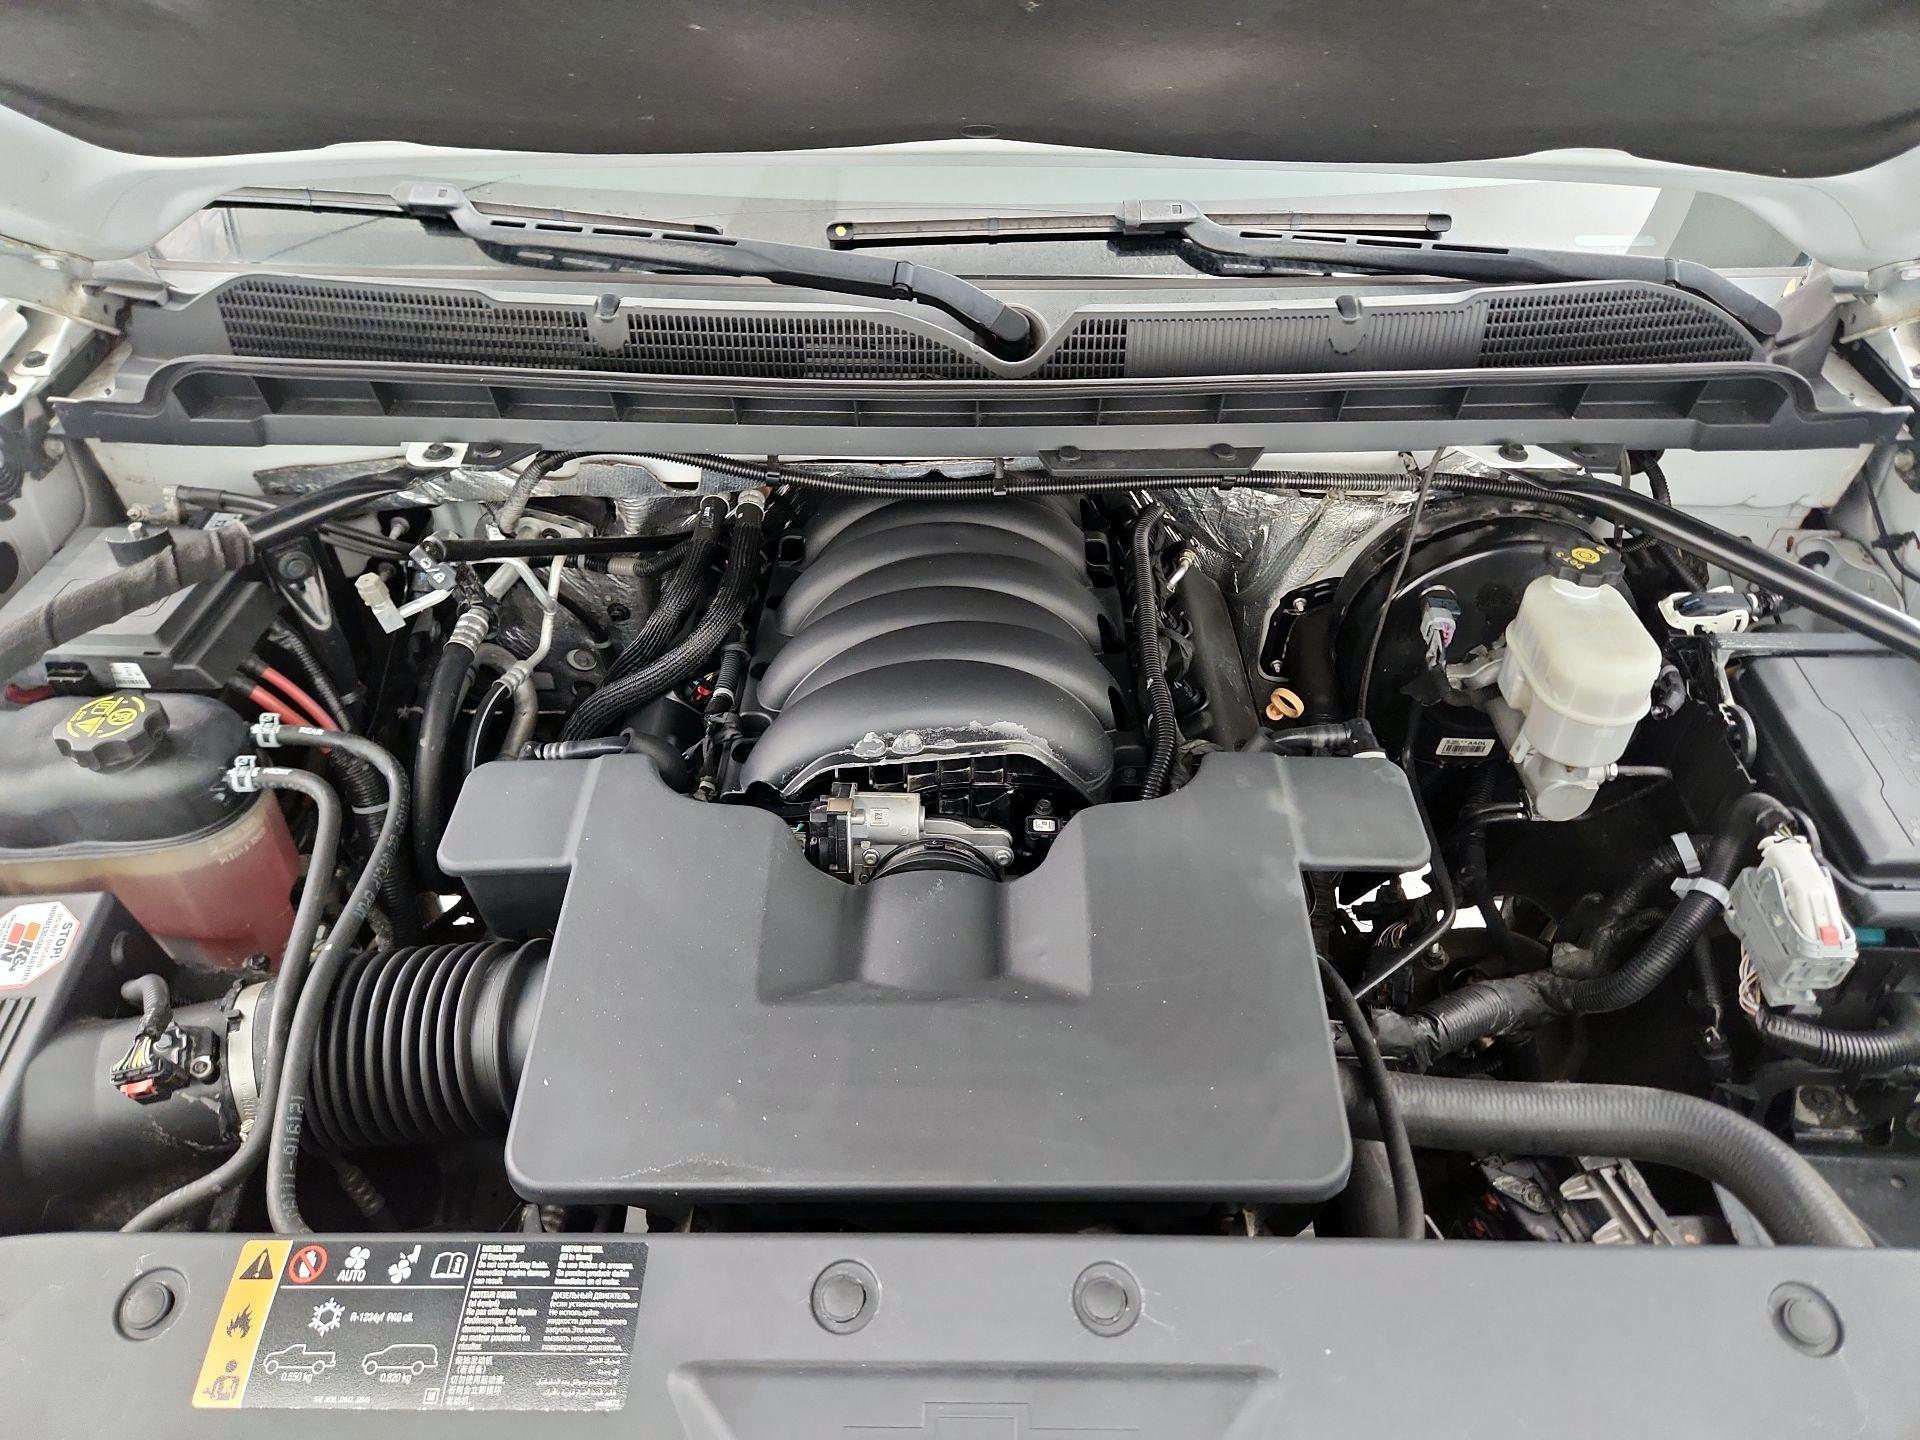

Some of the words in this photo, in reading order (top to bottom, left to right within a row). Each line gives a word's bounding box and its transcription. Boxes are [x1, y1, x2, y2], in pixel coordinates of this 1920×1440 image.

[262, 768, 292, 776] FRONT
[50, 922, 73, 959] STOP!
[336, 1269, 366, 1282] AUTO
[303, 1373, 312, 1383] kg
[402, 1373, 411, 1384] kg
